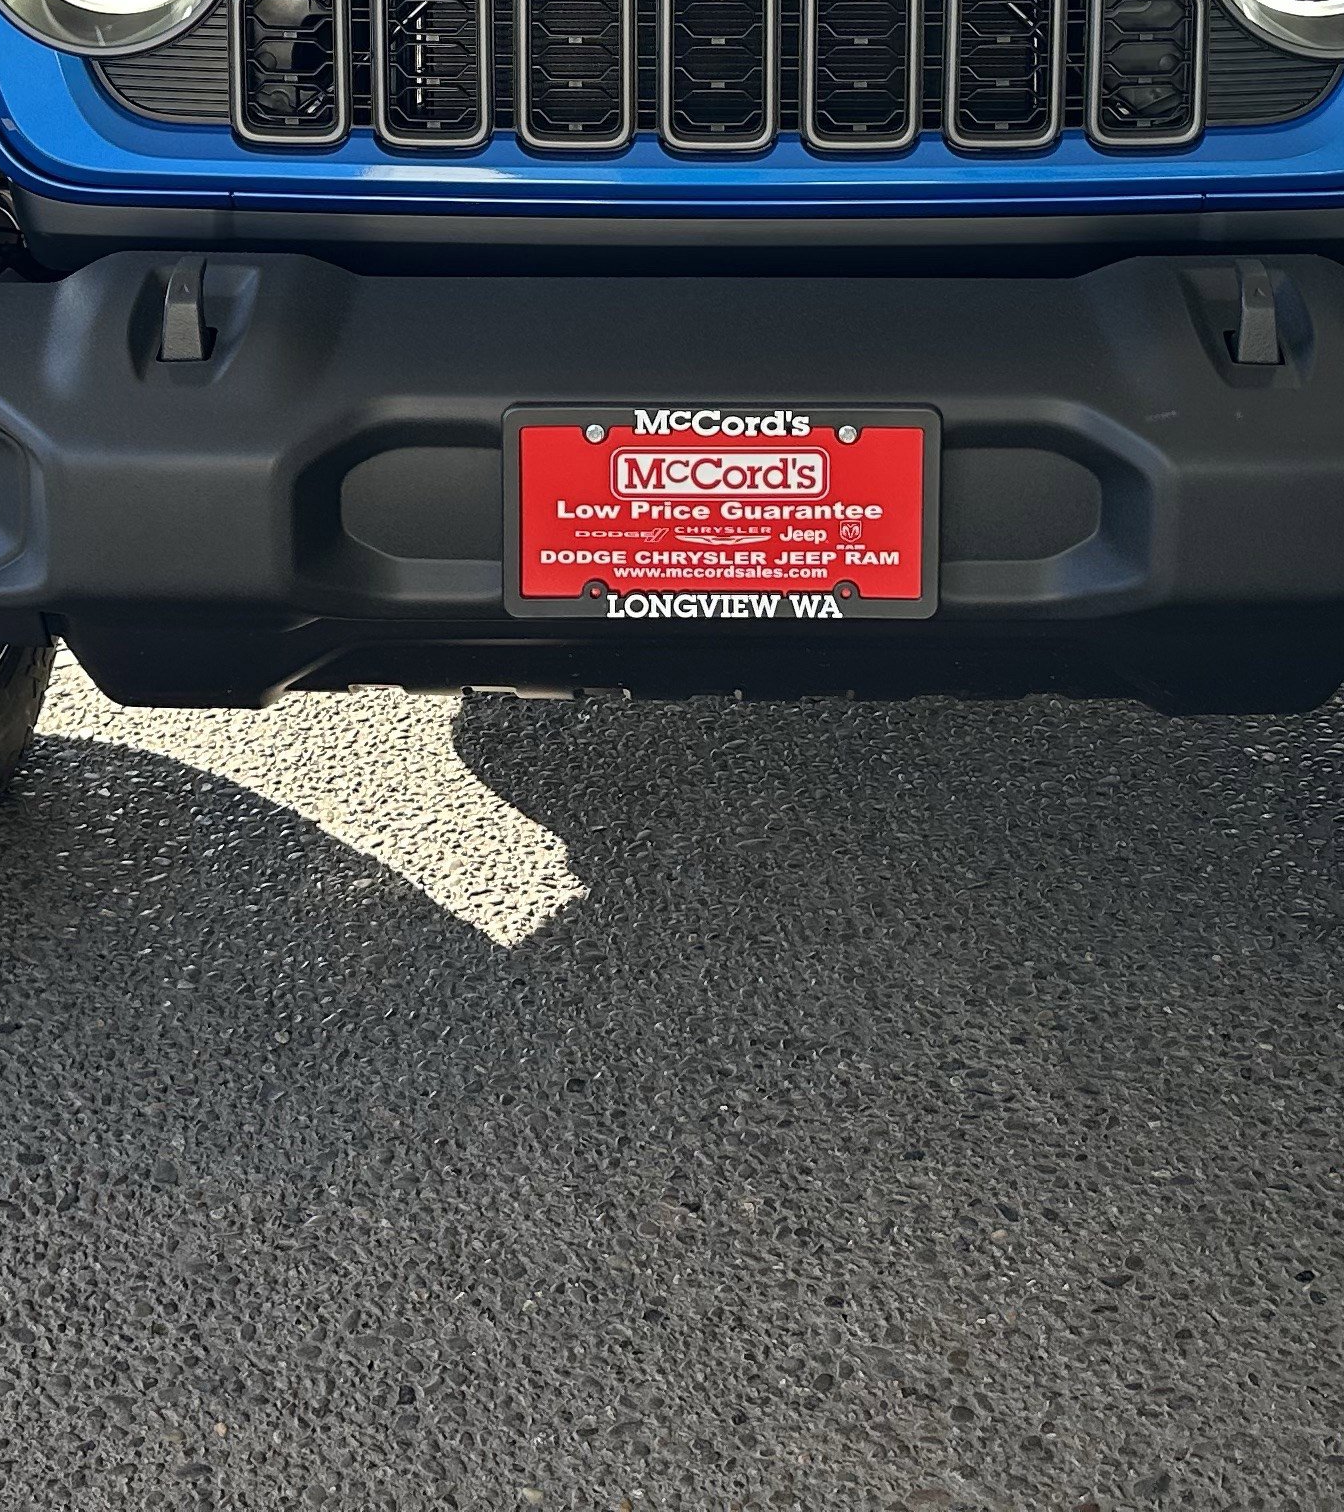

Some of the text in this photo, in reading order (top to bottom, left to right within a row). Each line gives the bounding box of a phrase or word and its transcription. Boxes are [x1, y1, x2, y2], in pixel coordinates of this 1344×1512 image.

[634, 409, 811, 437] McCord's
[624, 458, 816, 490] McCord's
[557, 500, 884, 520] Low Price Guarantee
[575, 530, 656, 538] DODGE
[674, 526, 772, 534] CHRYSLER
[779, 525, 828, 545] Jeep
[540, 550, 900, 565] DODGE CHRYSLER JEEP RAM
[613, 564, 828, 579] www.mccordsales.com
[606, 594, 844, 619] LONGVIEW WA
